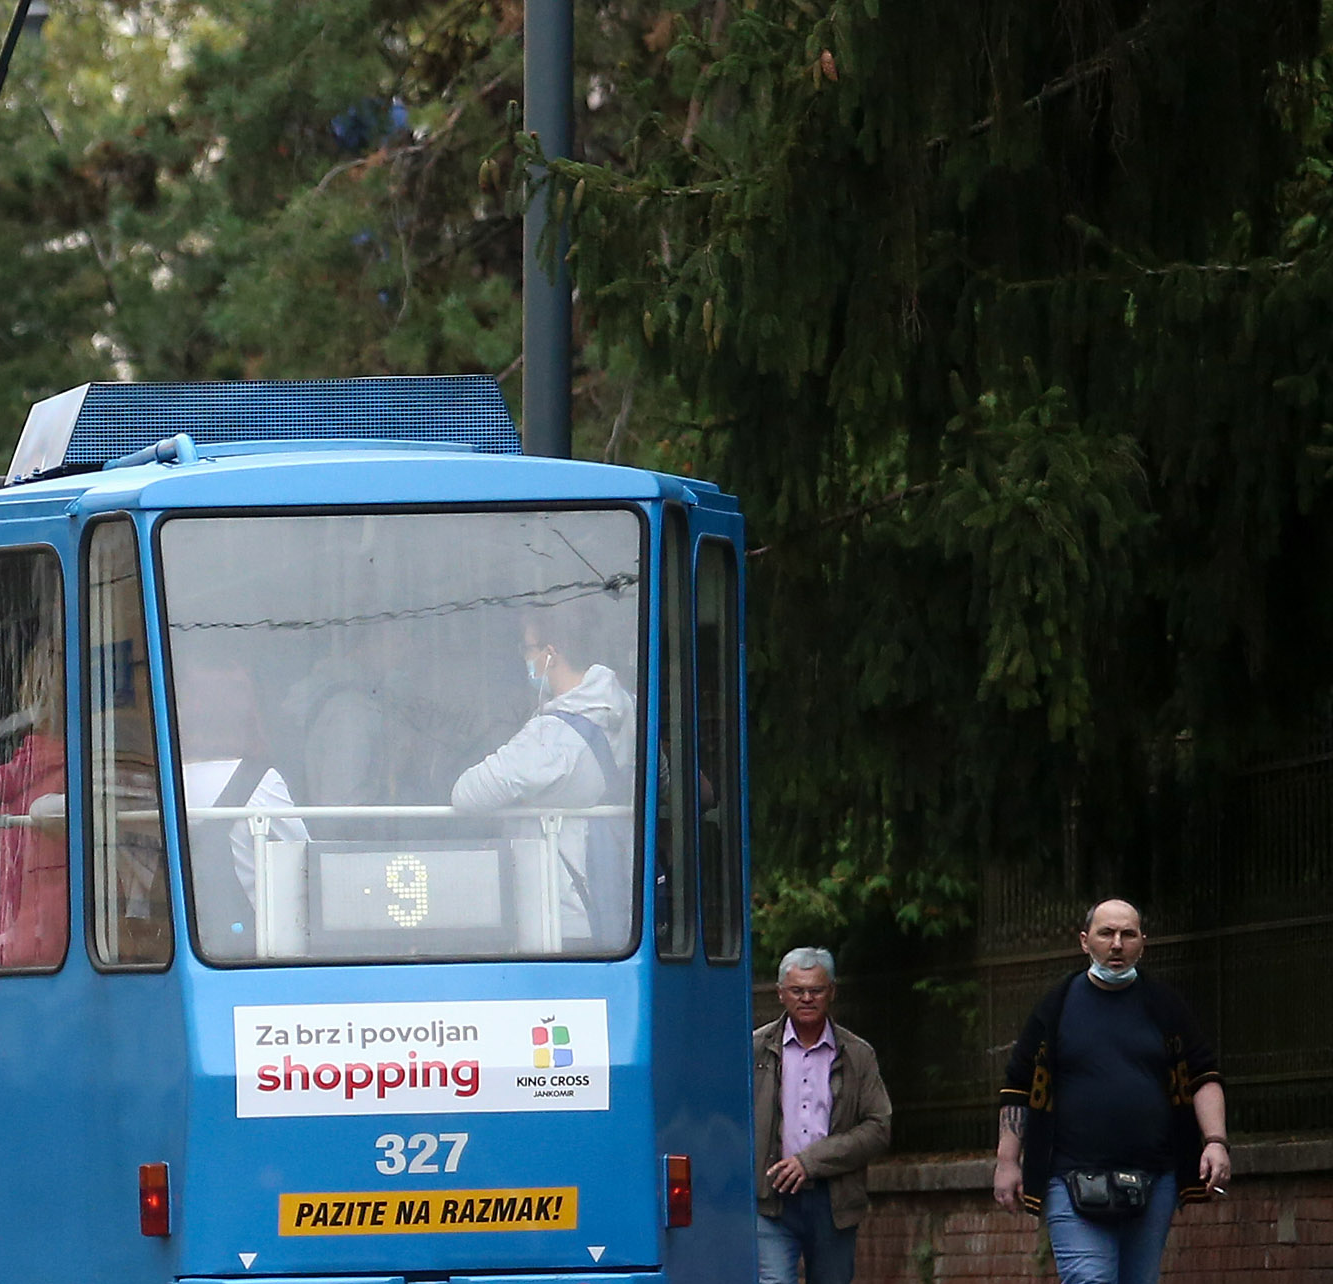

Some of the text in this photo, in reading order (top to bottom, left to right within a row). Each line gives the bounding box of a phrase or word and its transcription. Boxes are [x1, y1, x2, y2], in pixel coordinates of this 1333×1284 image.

[386, 854, 428, 927] 9
[255, 1020, 479, 1049] Za brz i povoljan
[256, 1050, 480, 1100] shopping
[516, 1075, 590, 1088] KING CROSS
[533, 1090, 574, 1098] JANKOMIR
[375, 1133, 469, 1175] 327
[294, 1196, 563, 1227] PAZITE NA RAZMAK!
